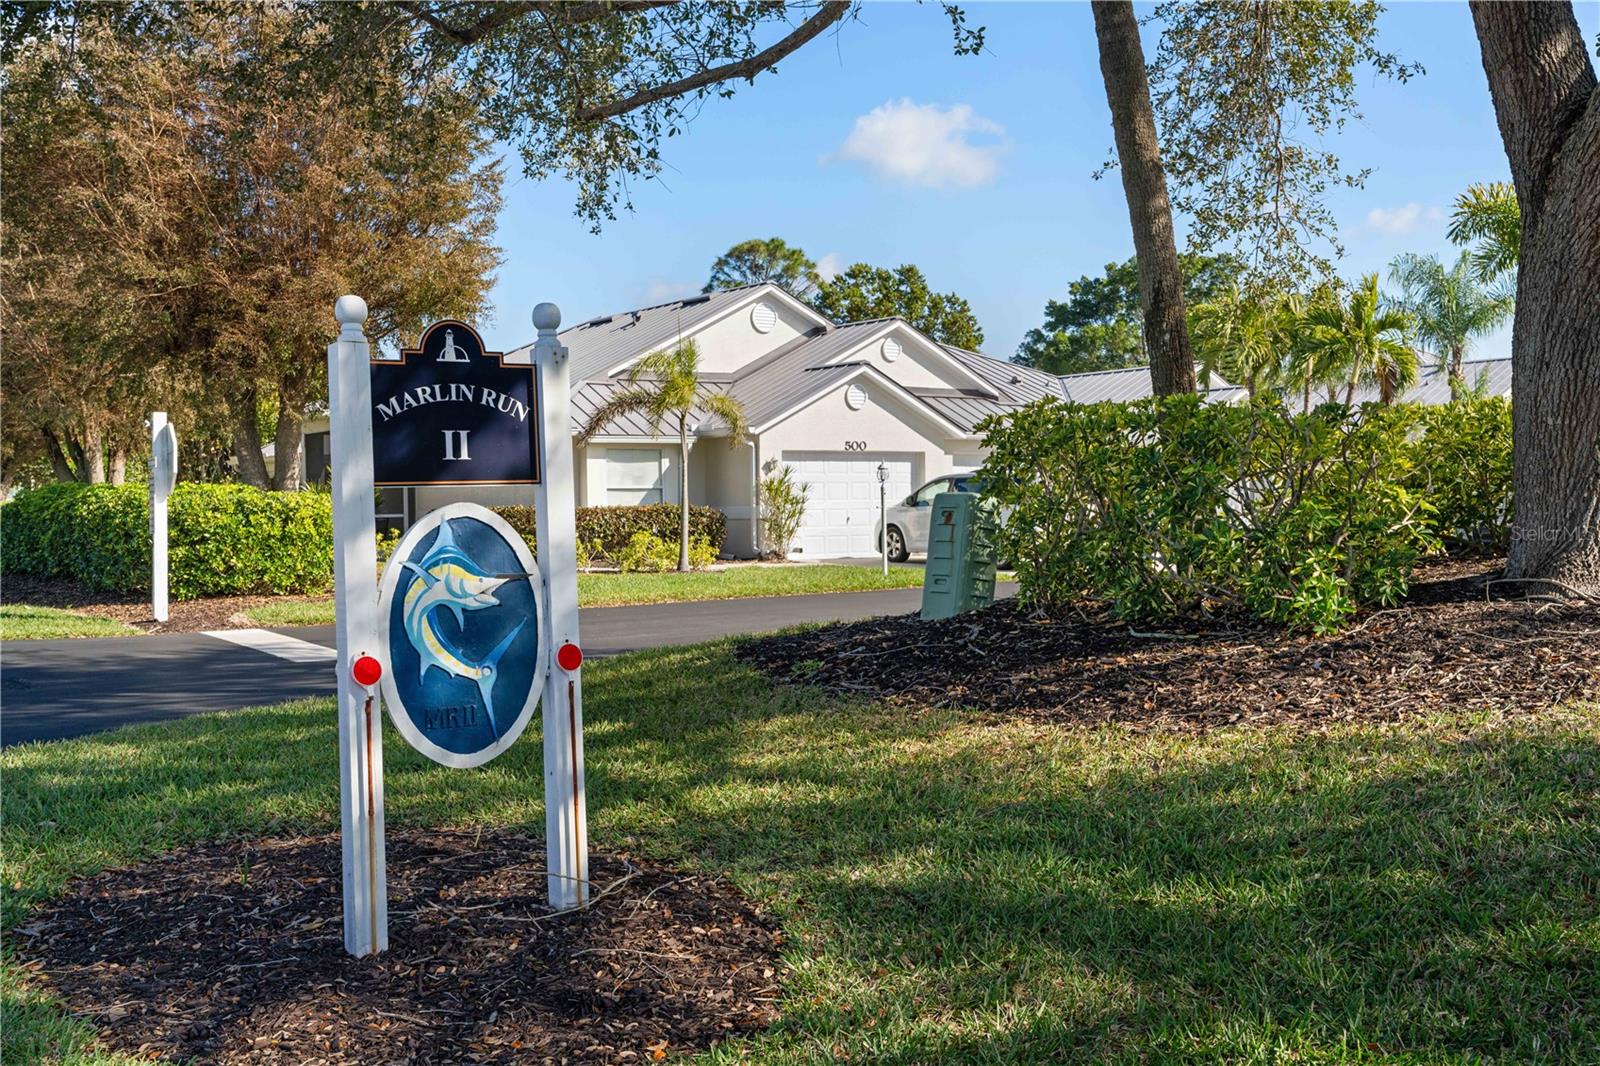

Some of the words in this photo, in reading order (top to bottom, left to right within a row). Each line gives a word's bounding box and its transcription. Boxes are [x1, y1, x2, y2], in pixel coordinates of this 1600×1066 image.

[375, 383, 476, 422] MARLIN
[481, 387, 531, 422] RUN
[844, 440, 867, 451] 500
